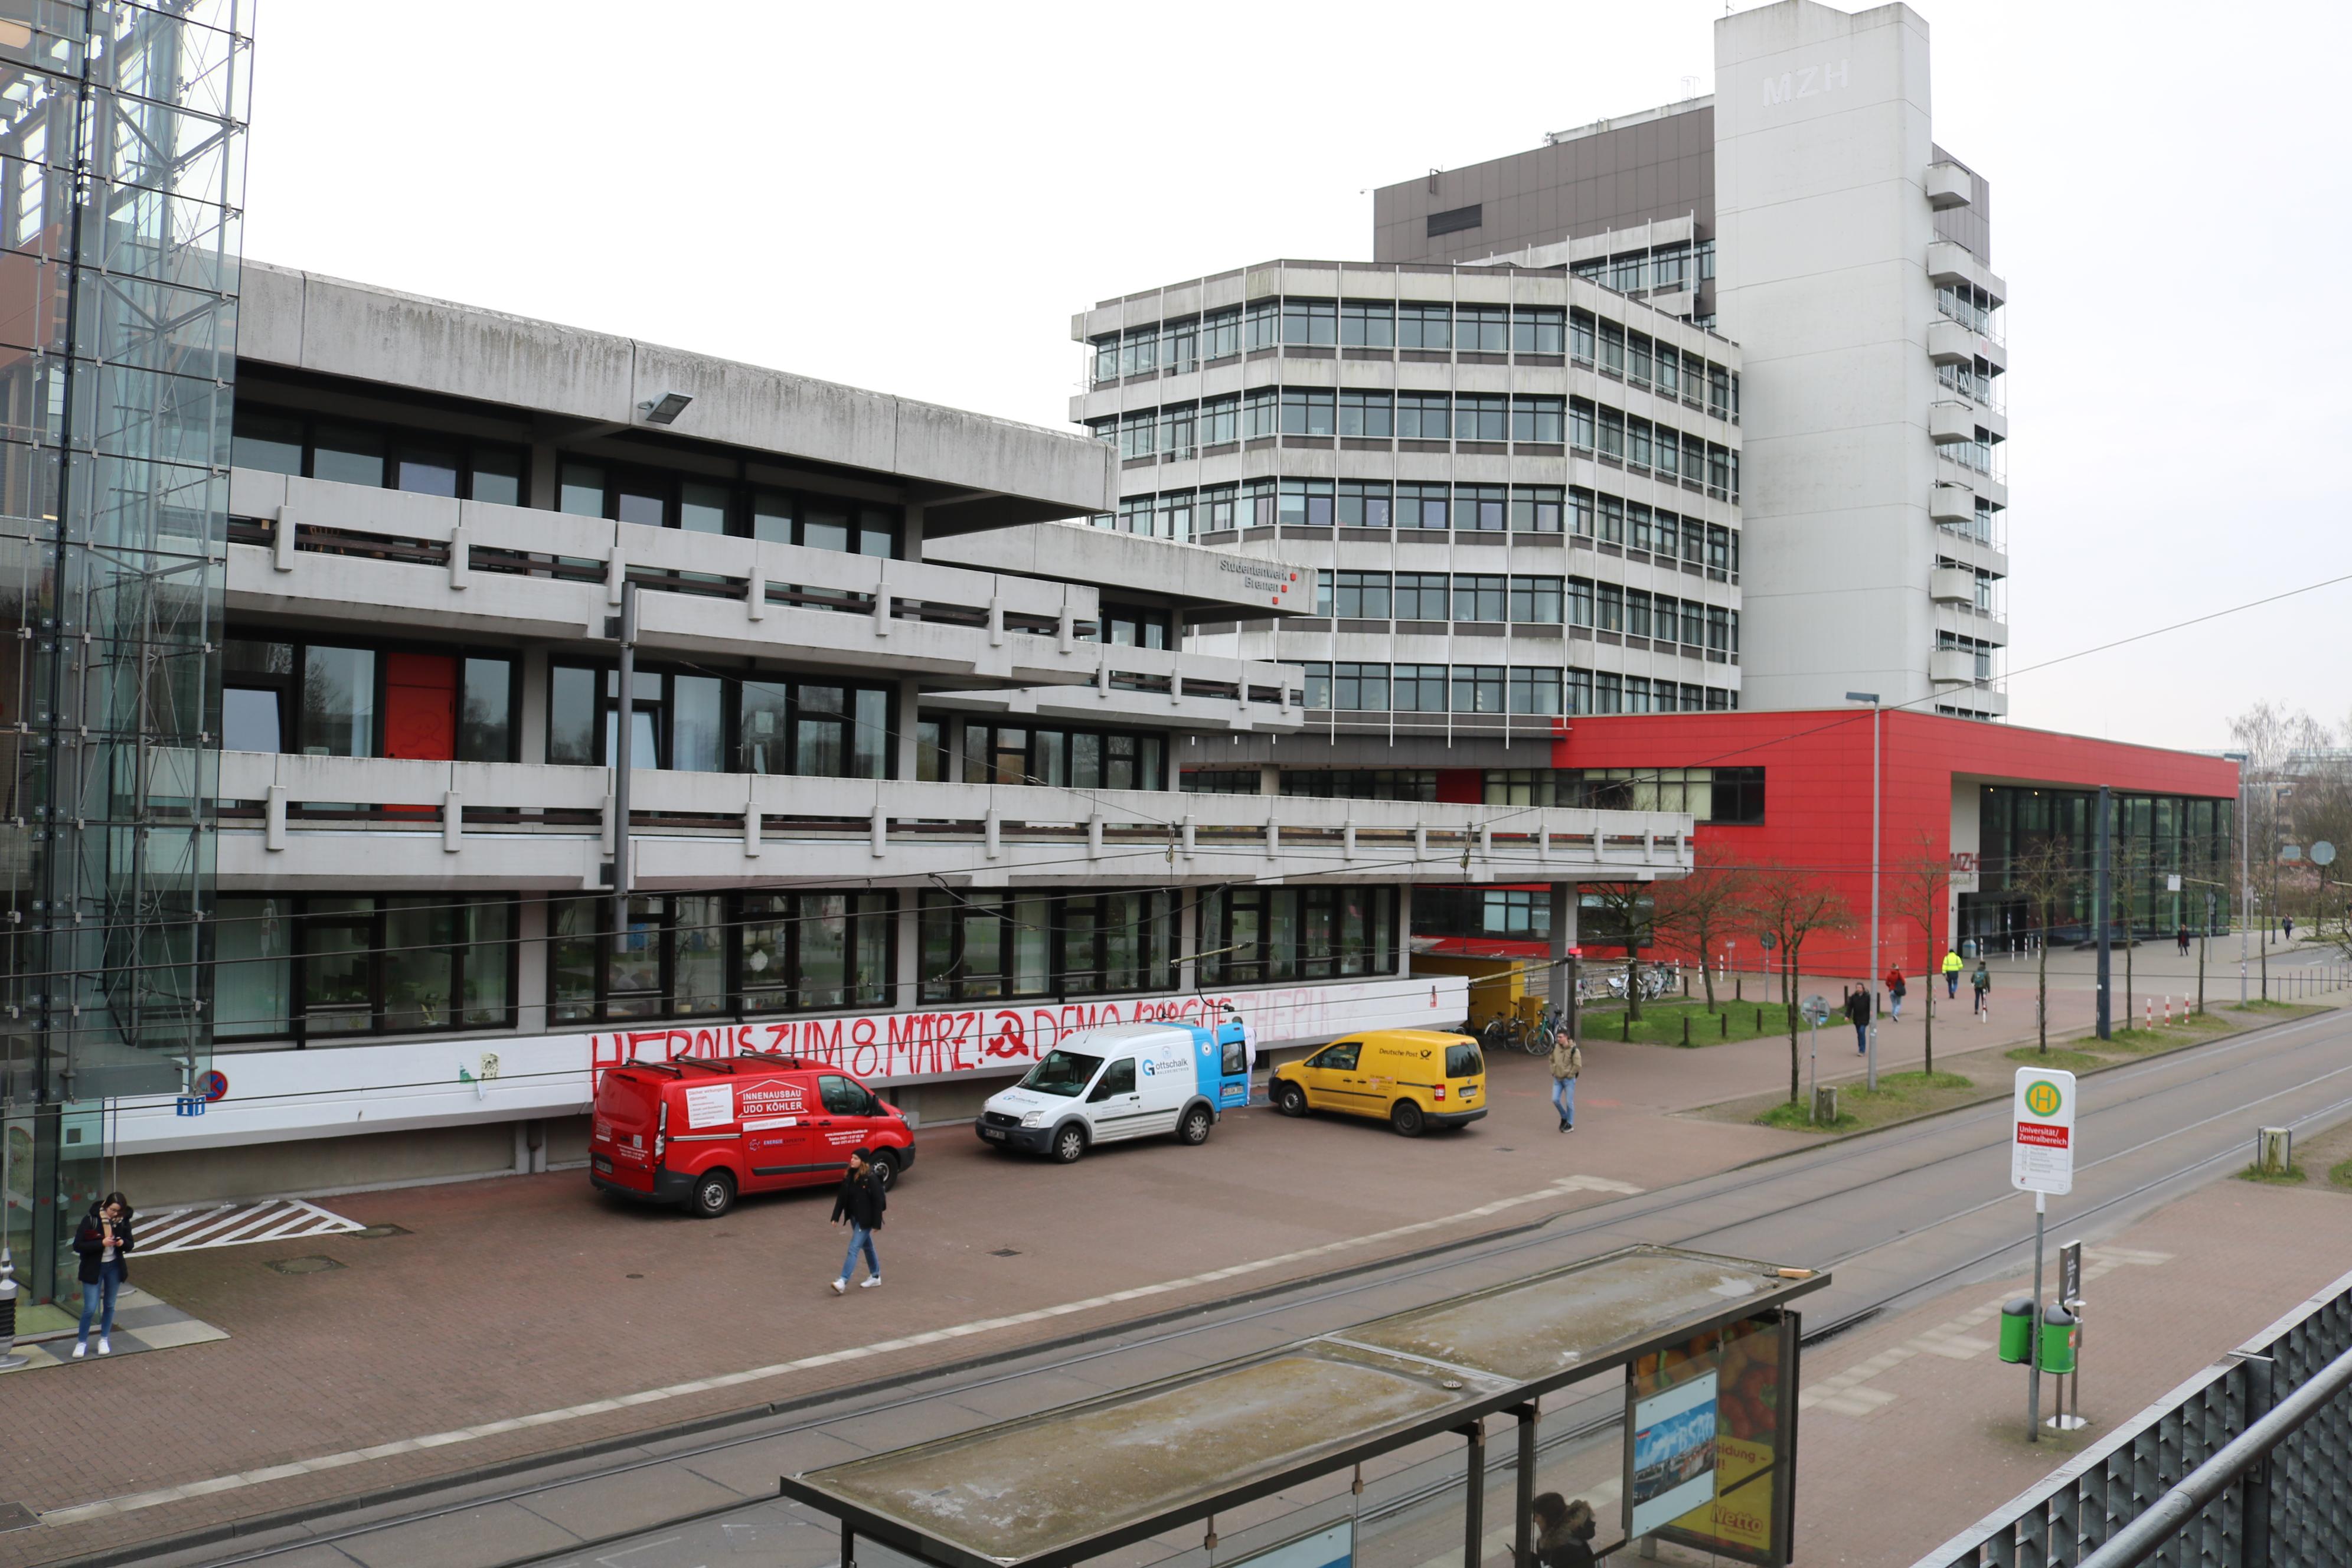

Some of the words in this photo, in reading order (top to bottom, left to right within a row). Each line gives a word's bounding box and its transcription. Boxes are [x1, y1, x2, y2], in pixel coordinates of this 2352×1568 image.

[1763, 58, 1848, 107] MZH
[1245, 576, 1278, 592] Bremen
[1950, 852, 1981, 871] MZH
[765, 1019, 843, 1070] ZUM
[1380, 1048, 1404, 1056] Deutsche
[743, 1090, 801, 1101] INNENAUSBAU
[743, 1105, 763, 1113] UDO
[766, 1102, 802, 1112] KÖHLER
[2019, 1125, 2060, 1137] Universität/
[2018, 1132, 2067, 1145] Zentralbereich
[1710, 1505, 1763, 1533] Netto
